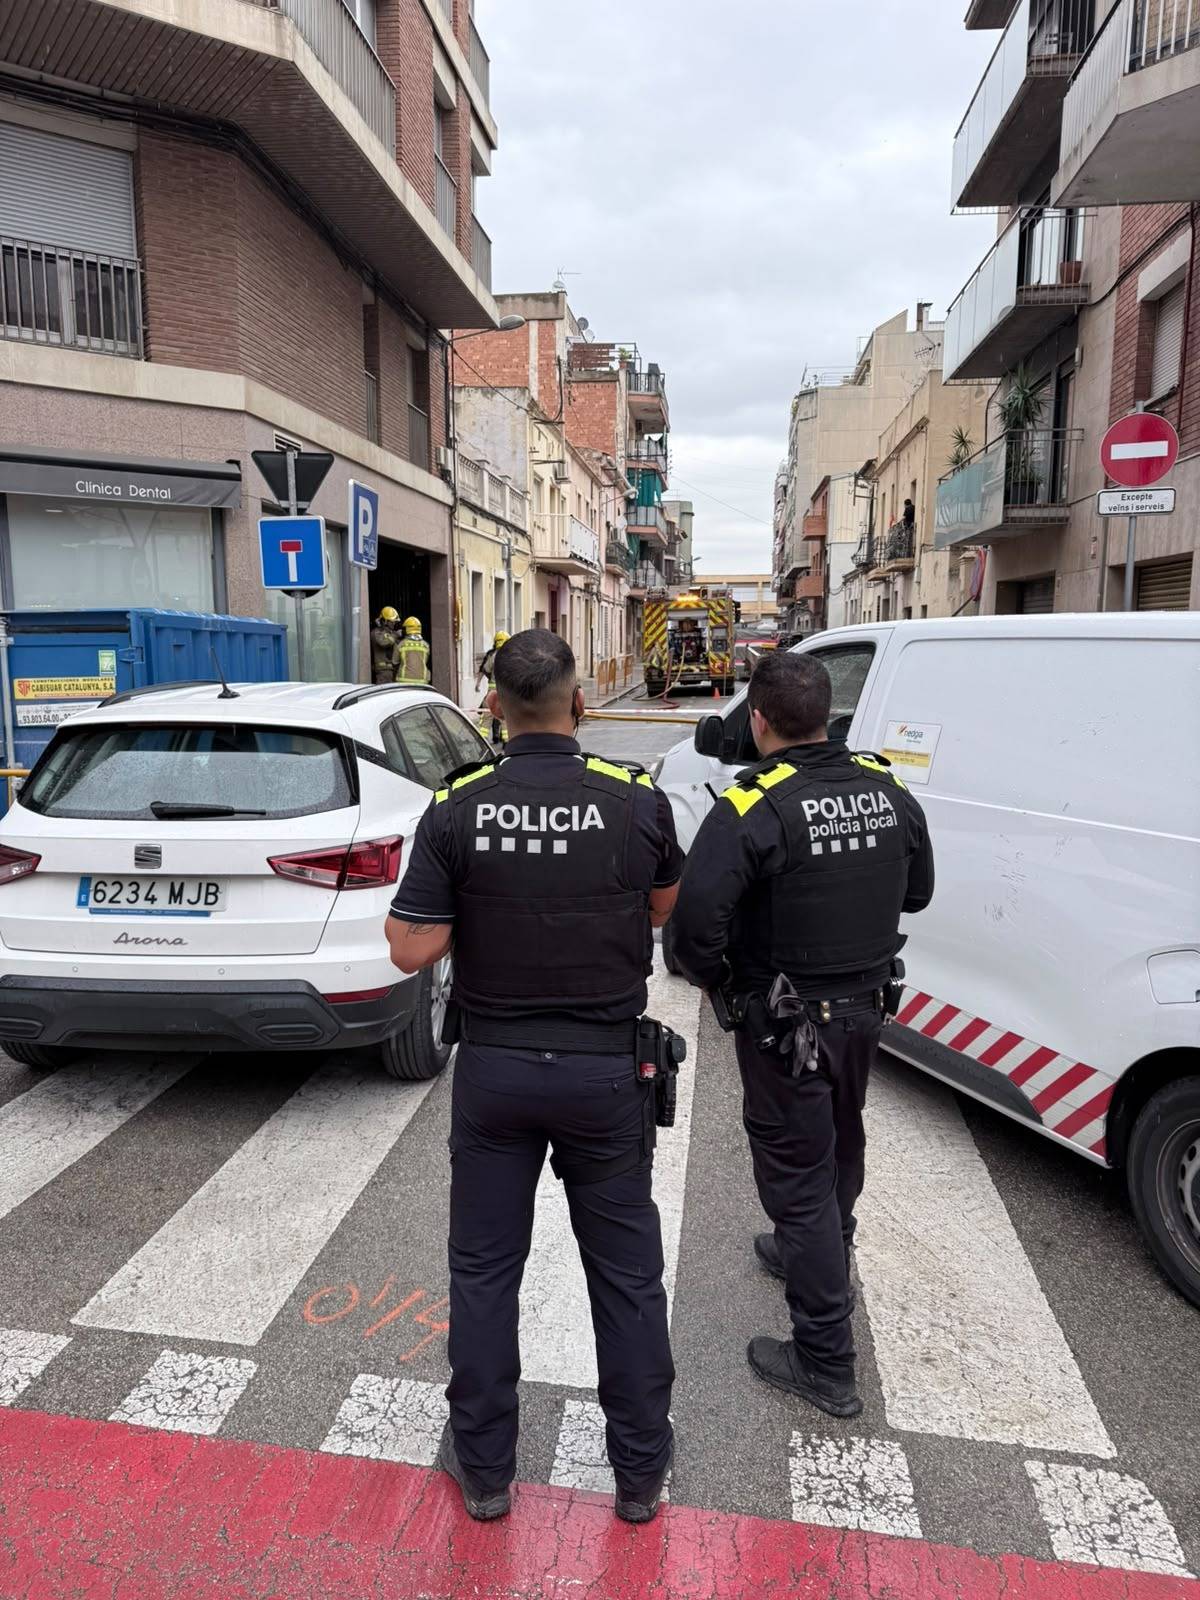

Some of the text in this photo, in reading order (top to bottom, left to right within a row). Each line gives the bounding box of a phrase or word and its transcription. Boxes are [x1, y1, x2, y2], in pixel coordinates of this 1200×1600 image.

[75, 480, 171, 500] Clínica Dental
[1121, 493, 1153, 502] Excepte
[1108, 503, 1130, 512] veïns
[1135, 502, 1165, 511] serveis
[358, 495, 373, 554] P
[31, 683, 62, 692] CABISUAR
[801, 790, 894, 822] POLICIA
[476, 803, 605, 833] POLICIA
[808, 811, 898, 842] policia local
[93, 880, 158, 905] 6234
[168, 881, 220, 906] MJB
[113, 931, 188, 946] Arona
